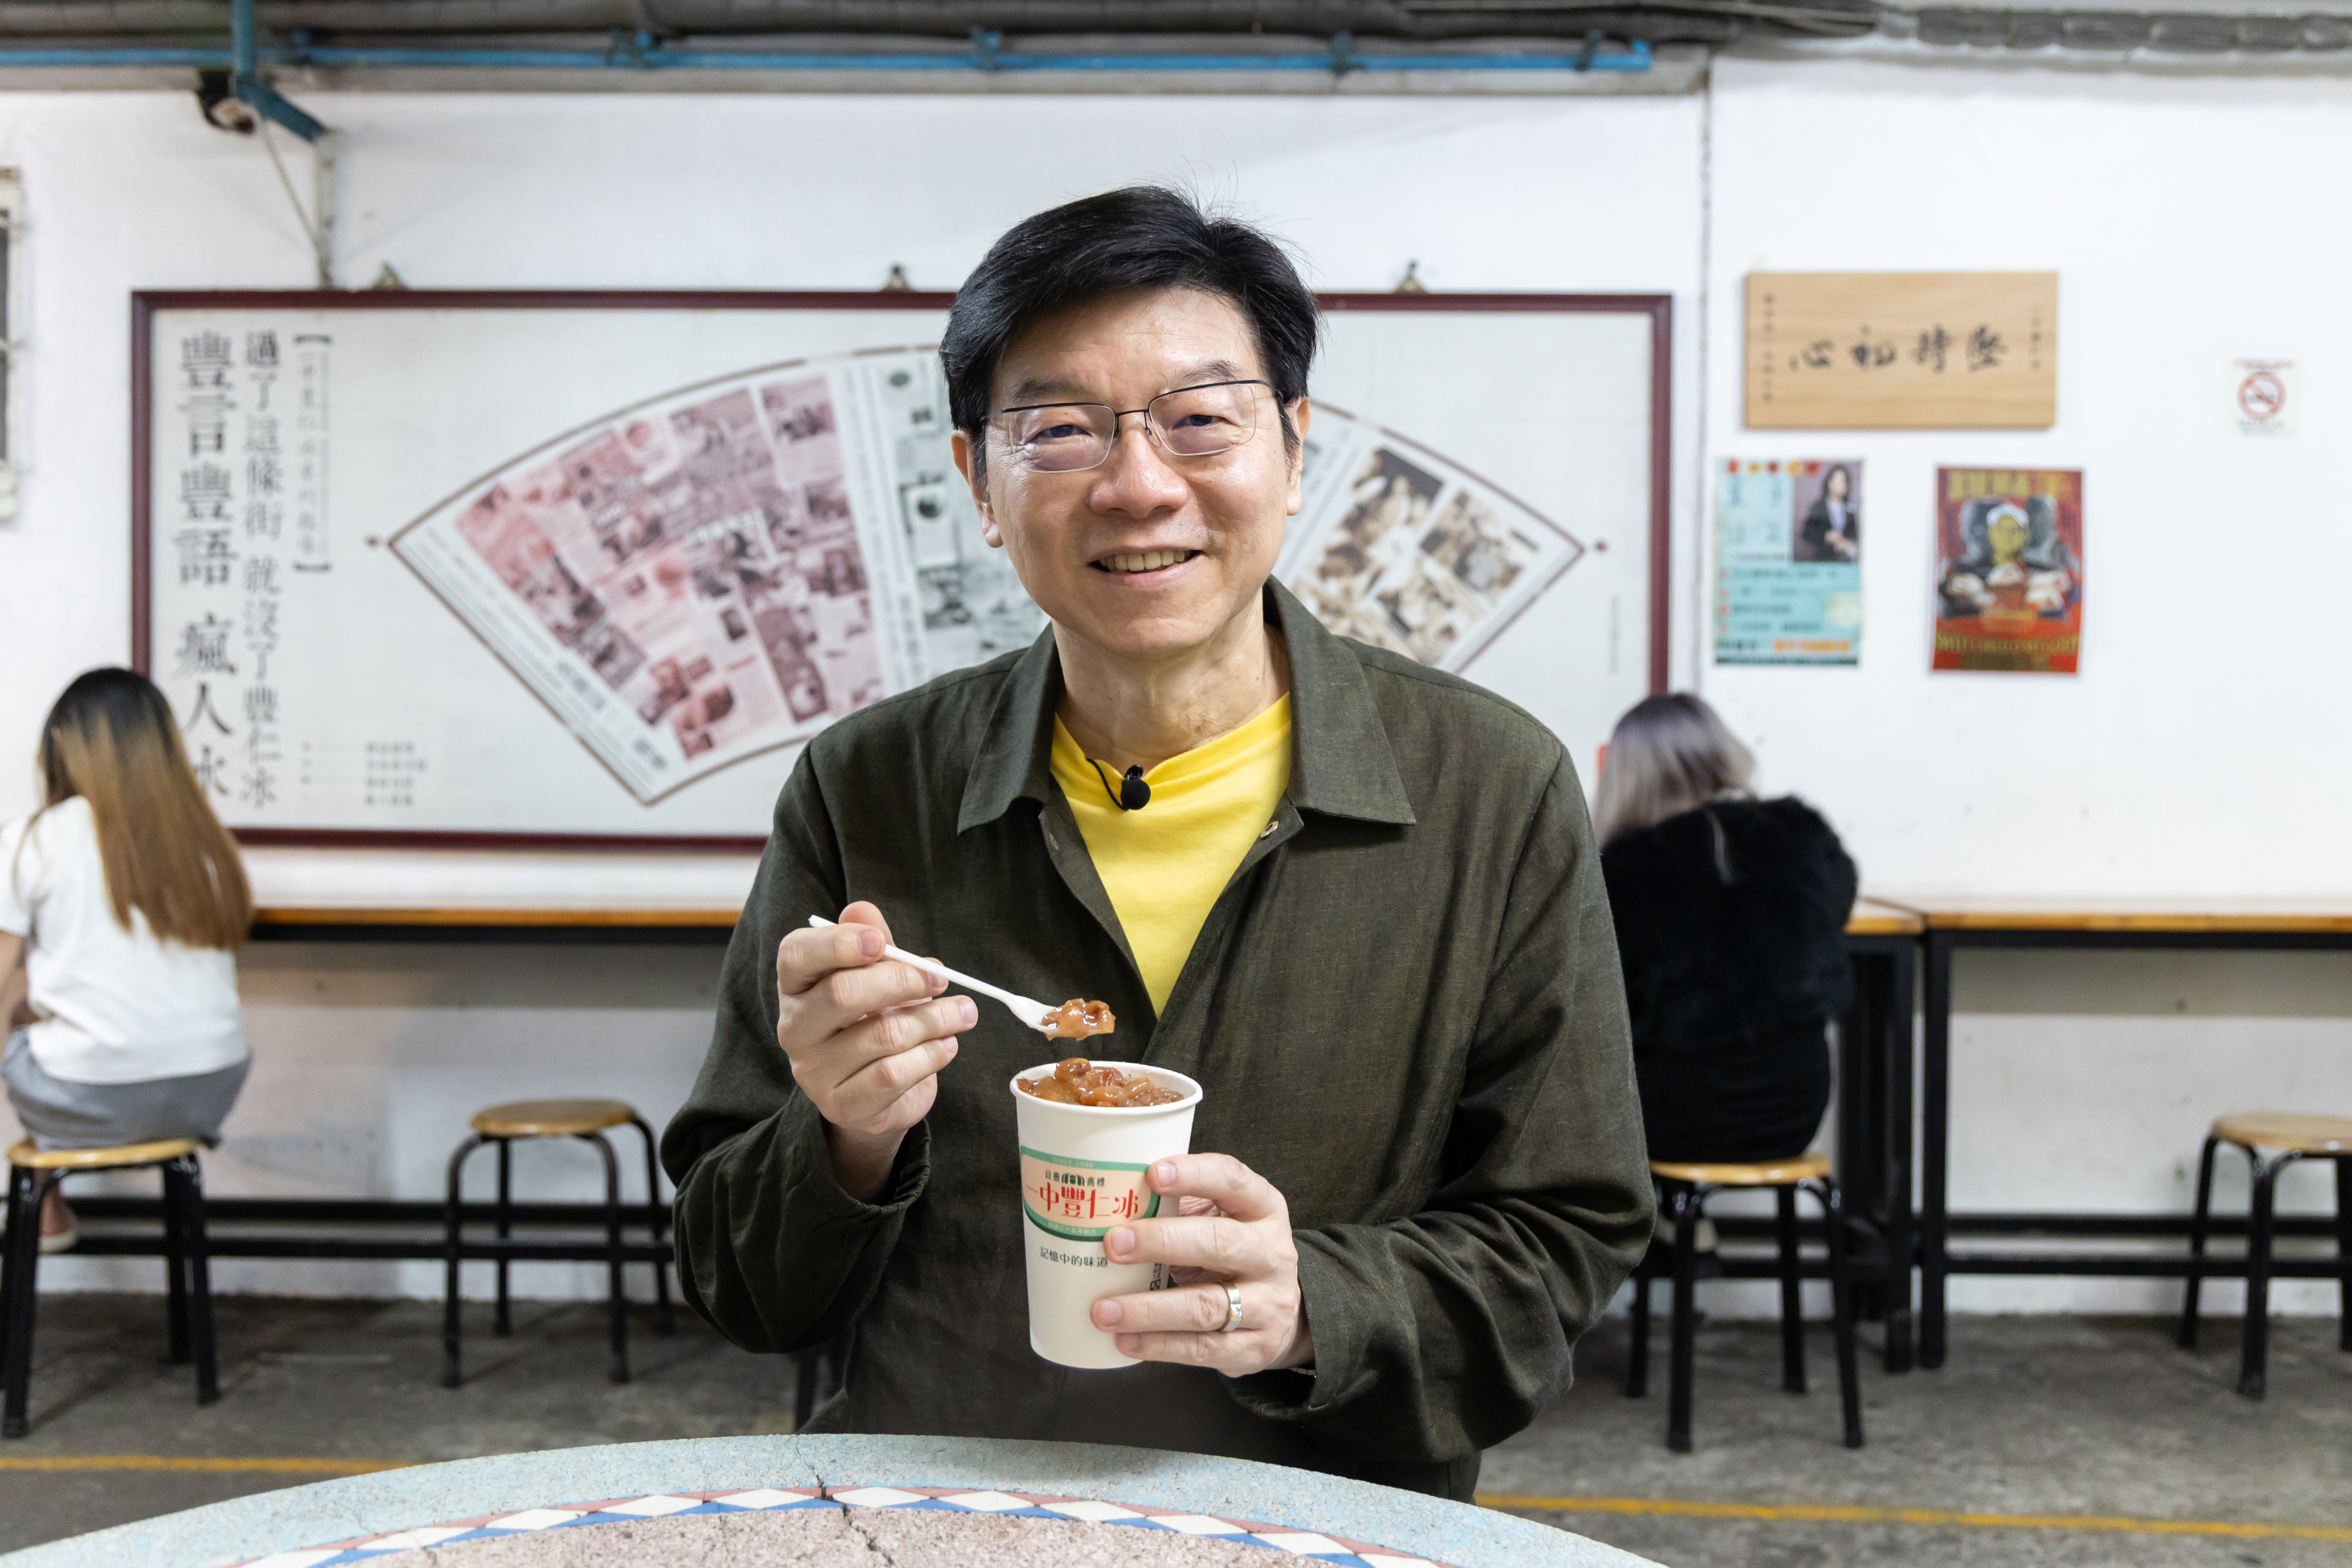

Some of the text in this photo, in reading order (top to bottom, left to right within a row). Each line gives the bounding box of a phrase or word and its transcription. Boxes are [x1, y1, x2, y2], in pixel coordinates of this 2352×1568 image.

[172, 328, 239, 585] 豐言豐語
[1040, 1246, 1108, 1267] 記憶中的味道
